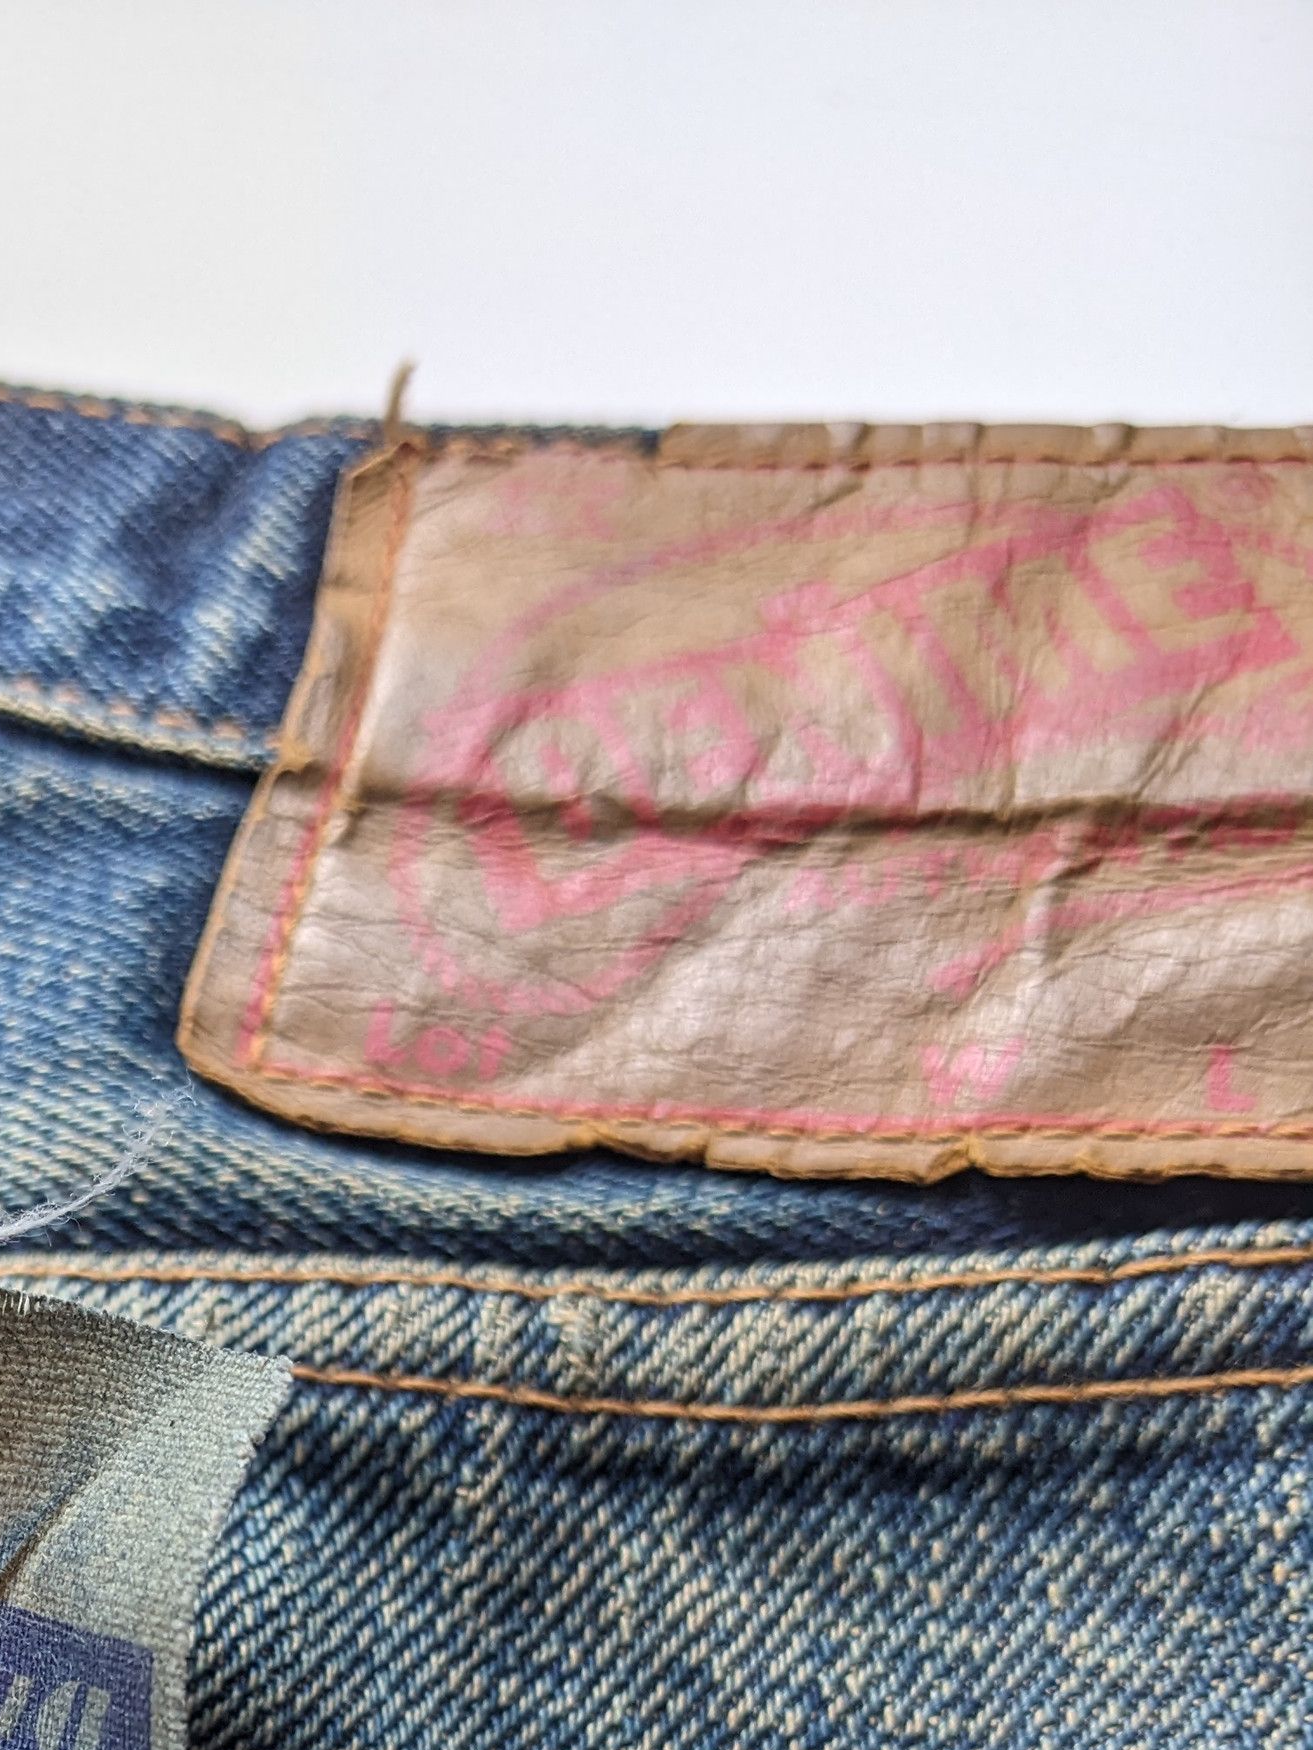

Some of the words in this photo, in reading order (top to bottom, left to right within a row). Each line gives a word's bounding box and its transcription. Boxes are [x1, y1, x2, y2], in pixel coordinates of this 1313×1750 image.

[486, 511, 1260, 883] DENIME
[920, 1037, 1025, 1106] W
[1205, 1043, 1257, 1111] L
